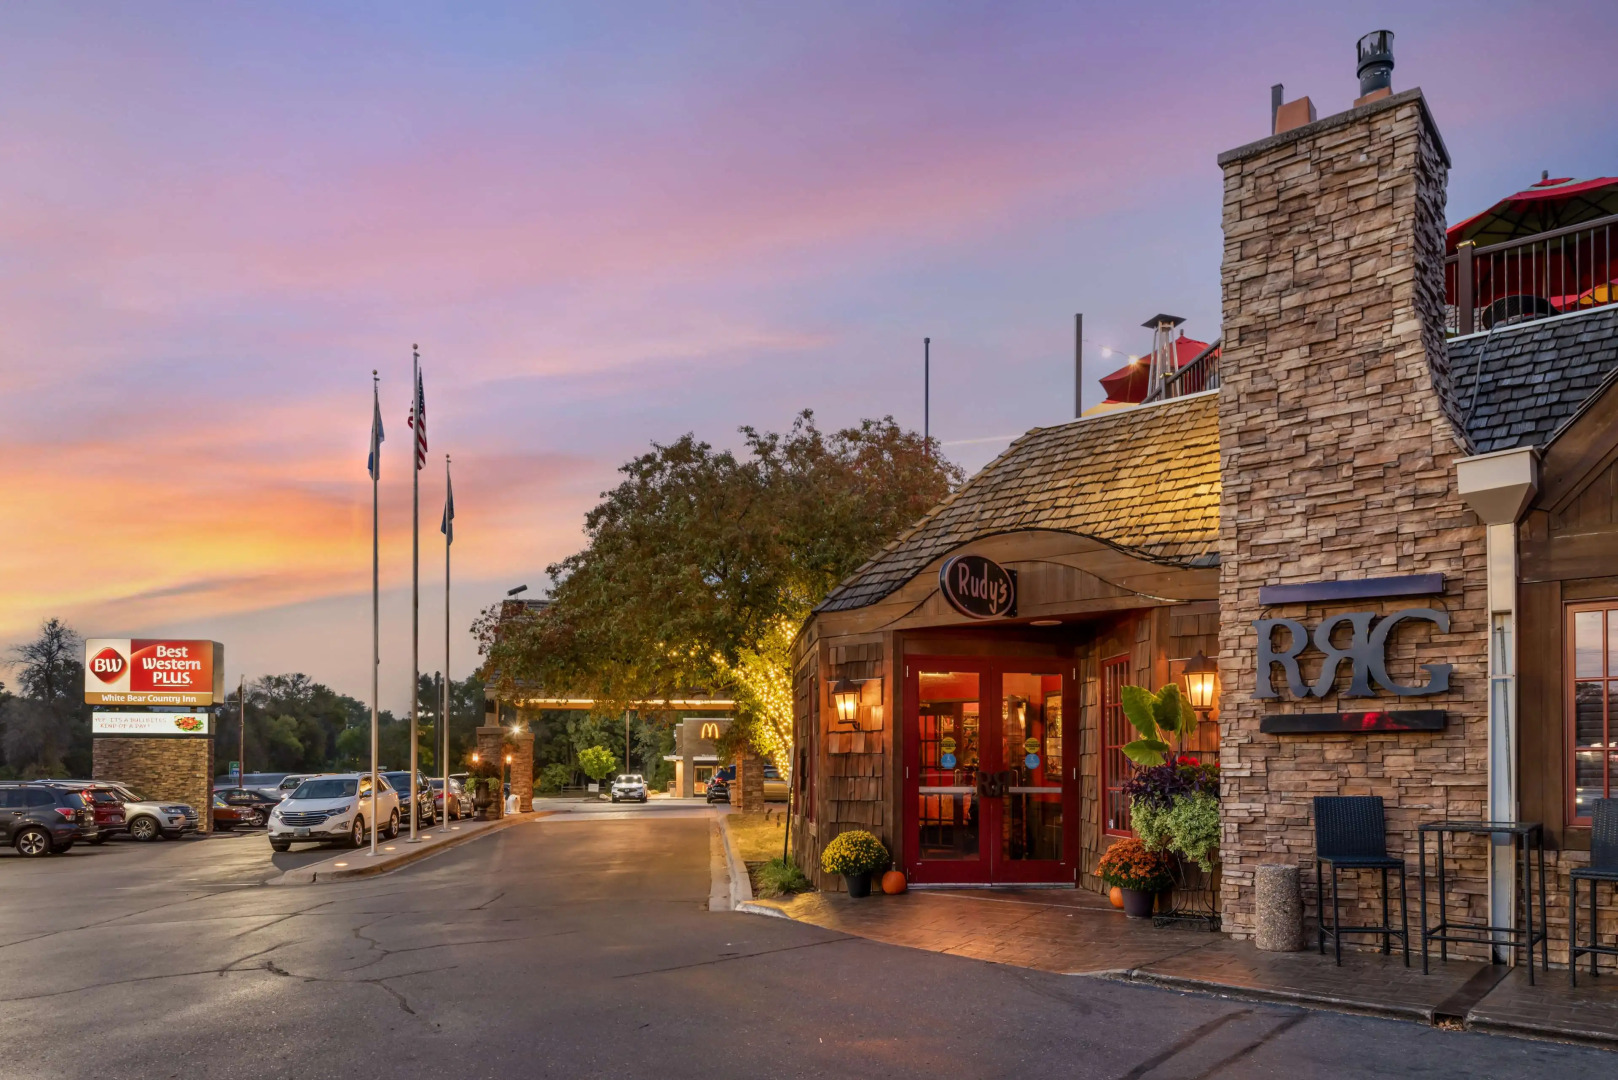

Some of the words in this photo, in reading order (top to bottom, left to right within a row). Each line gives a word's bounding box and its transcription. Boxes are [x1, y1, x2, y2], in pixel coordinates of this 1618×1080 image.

[958, 562, 1008, 614] Rudy's
[156, 645, 188, 658] Best
[94, 658, 122, 673] BW
[142, 657, 201, 670] Western
[101, 694, 125, 702] White
[147, 695, 181, 704] Country
[182, 695, 197, 703] Inn
